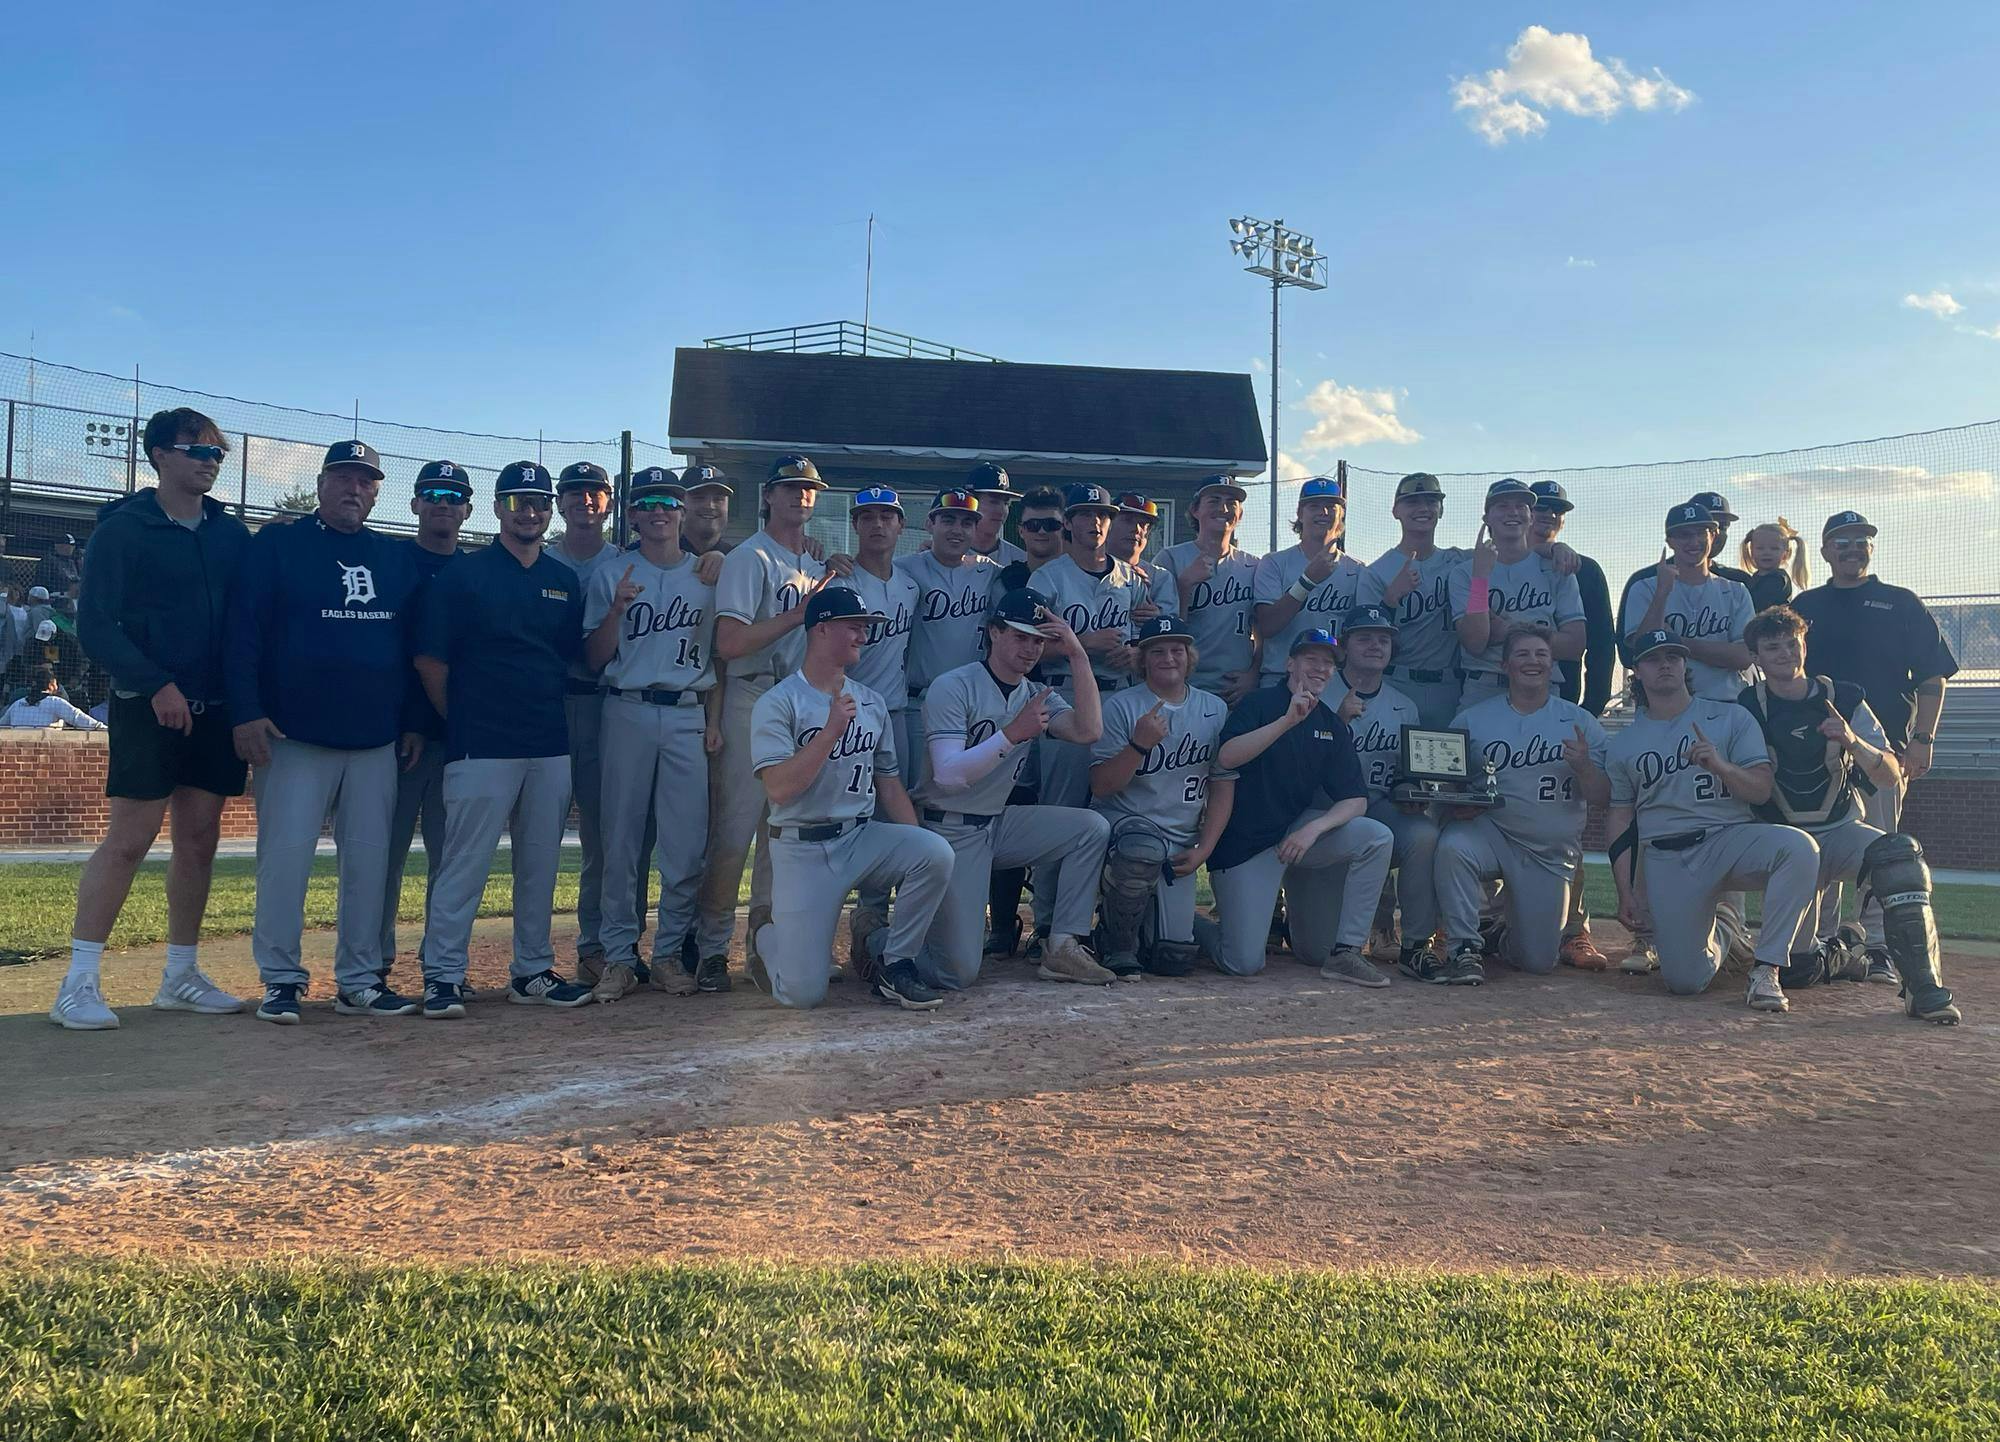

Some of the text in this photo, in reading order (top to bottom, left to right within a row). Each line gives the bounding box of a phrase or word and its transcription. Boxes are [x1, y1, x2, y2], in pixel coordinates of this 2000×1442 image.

[351, 443, 365, 458] D
[440, 463, 453, 477] D
[521, 467, 536, 482] D
[650, 469, 663, 482] D
[701, 466, 714, 480] D
[1087, 488, 1100, 502] D
[1712, 496, 1723, 508] D
[1683, 507, 1697, 520] D
[1844, 512, 1857, 523] D
[337, 560, 377, 607] D
[1189, 575, 1253, 613] Delta
[1285, 583, 1352, 613] elta
[923, 585, 988, 622] Delta
[1400, 576, 1450, 624] Delt
[1488, 582, 1553, 617] Delta
[321, 609, 397, 620] EAGLES BASEBA
[626, 595, 703, 641] Delta
[1063, 597, 1129, 637] Delta
[1159, 619, 1172, 633] D
[1665, 606, 1732, 639] Delta
[1653, 630, 1667, 643] D
[675, 638, 703, 671] 14
[1348, 721, 1400, 753] elta
[1136, 732, 1211, 777] Delta
[1482, 734, 1566, 773] Delta
[1636, 735, 1699, 790] Del
[1539, 775, 1574, 801] 24
[1694, 773, 1732, 801] 21
